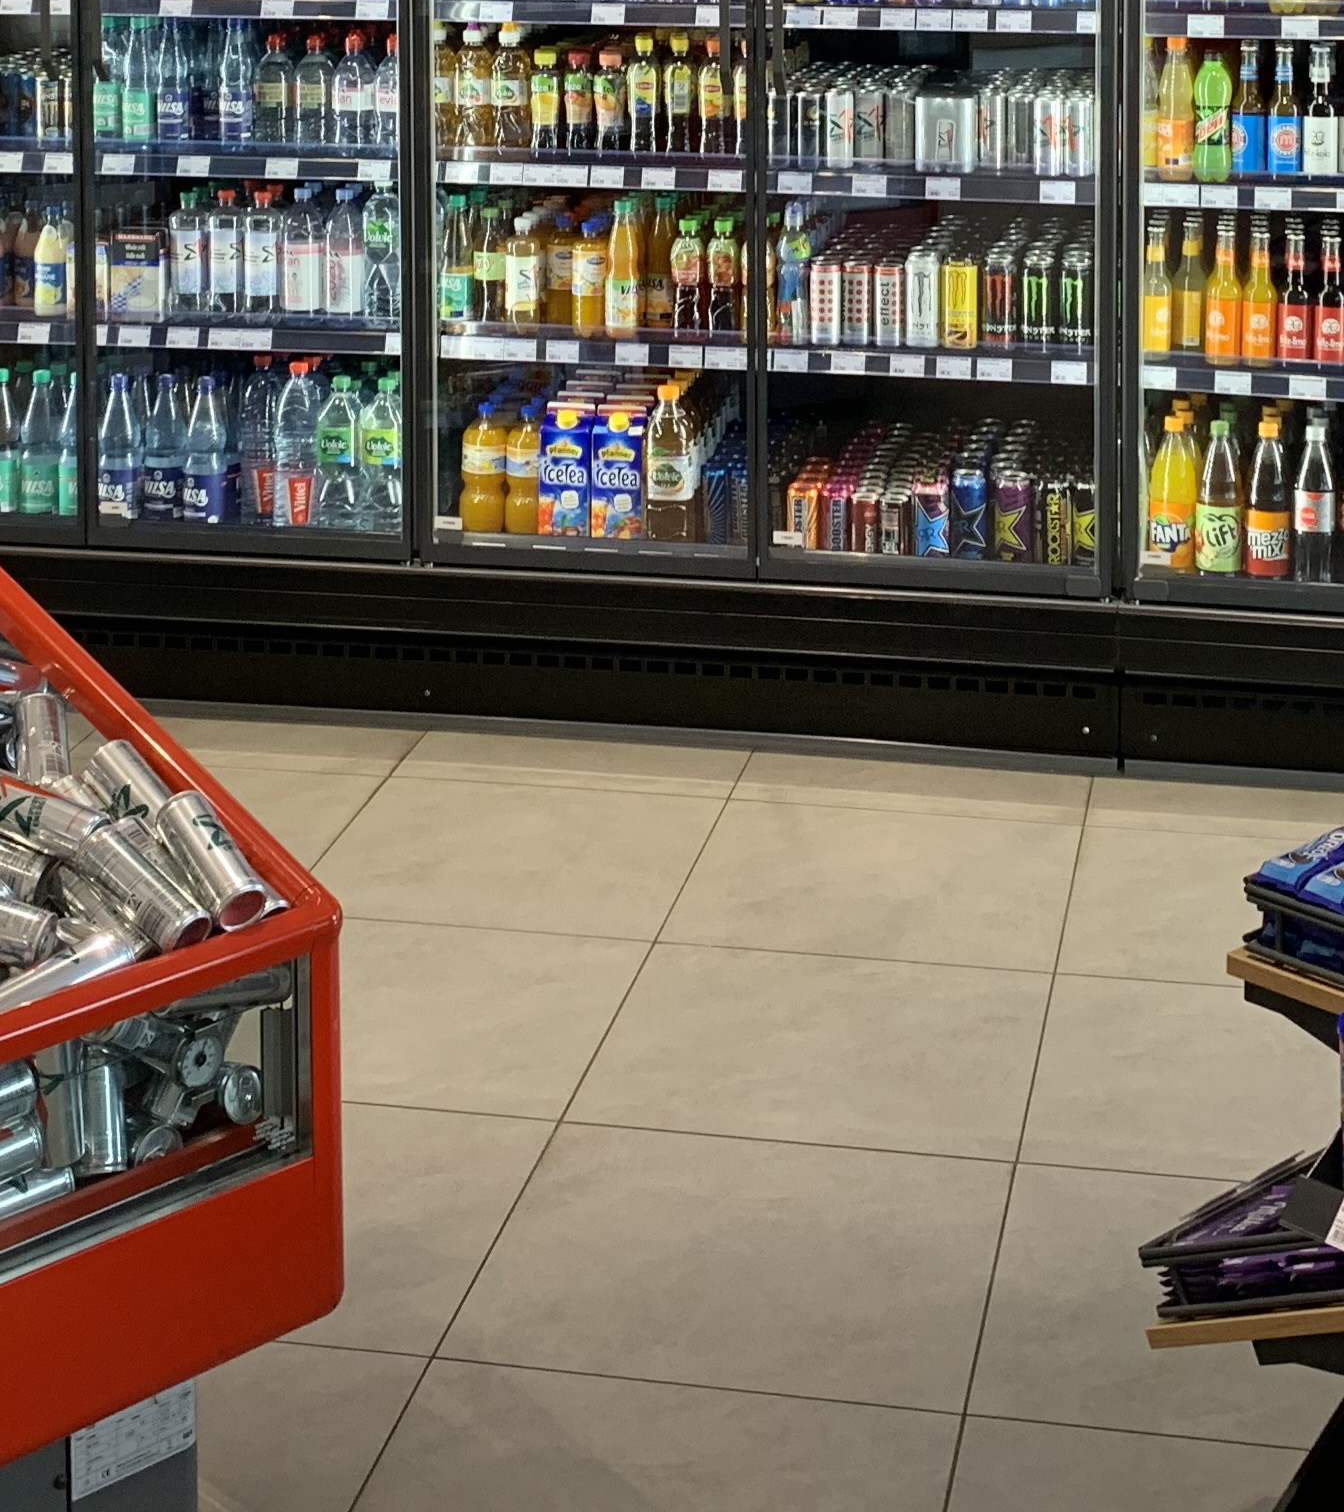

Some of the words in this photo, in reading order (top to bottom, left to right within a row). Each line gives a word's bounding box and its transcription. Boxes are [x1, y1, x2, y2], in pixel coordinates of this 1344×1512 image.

[879, 281, 891, 327] effect
[143, 478, 176, 500] VILSA
[293, 480, 307, 514] Vittel
[831, 498, 843, 552] BOOSTER
[1151, 522, 1191, 545] FANTA
[1251, 541, 1286, 560] mix
